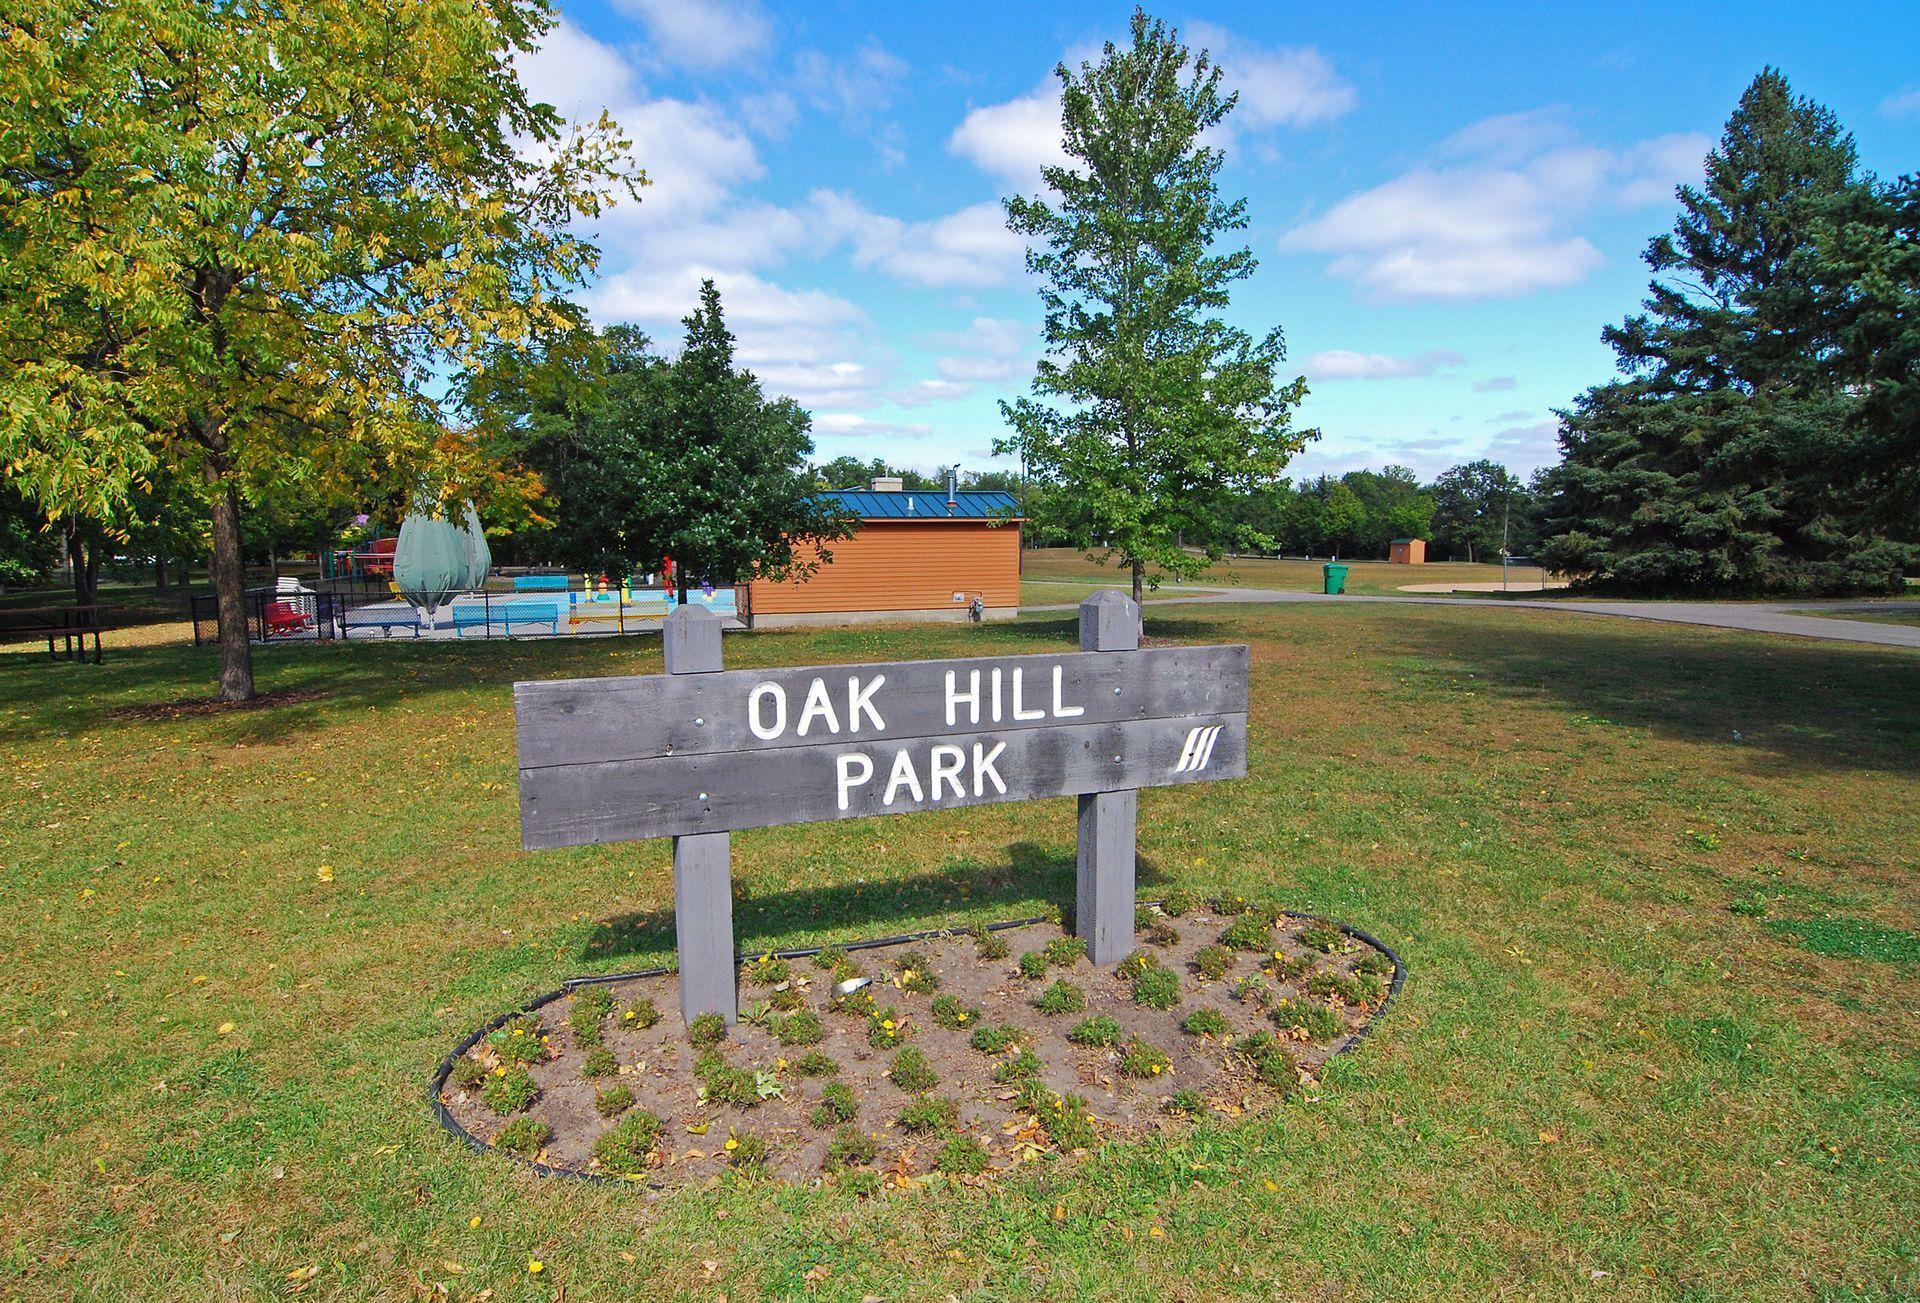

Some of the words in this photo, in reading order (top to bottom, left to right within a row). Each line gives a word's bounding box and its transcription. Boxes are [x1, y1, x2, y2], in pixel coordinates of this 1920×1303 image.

[748, 674, 886, 741] OAK
[945, 664, 1085, 726] HILL
[836, 740, 1007, 811] PARK
